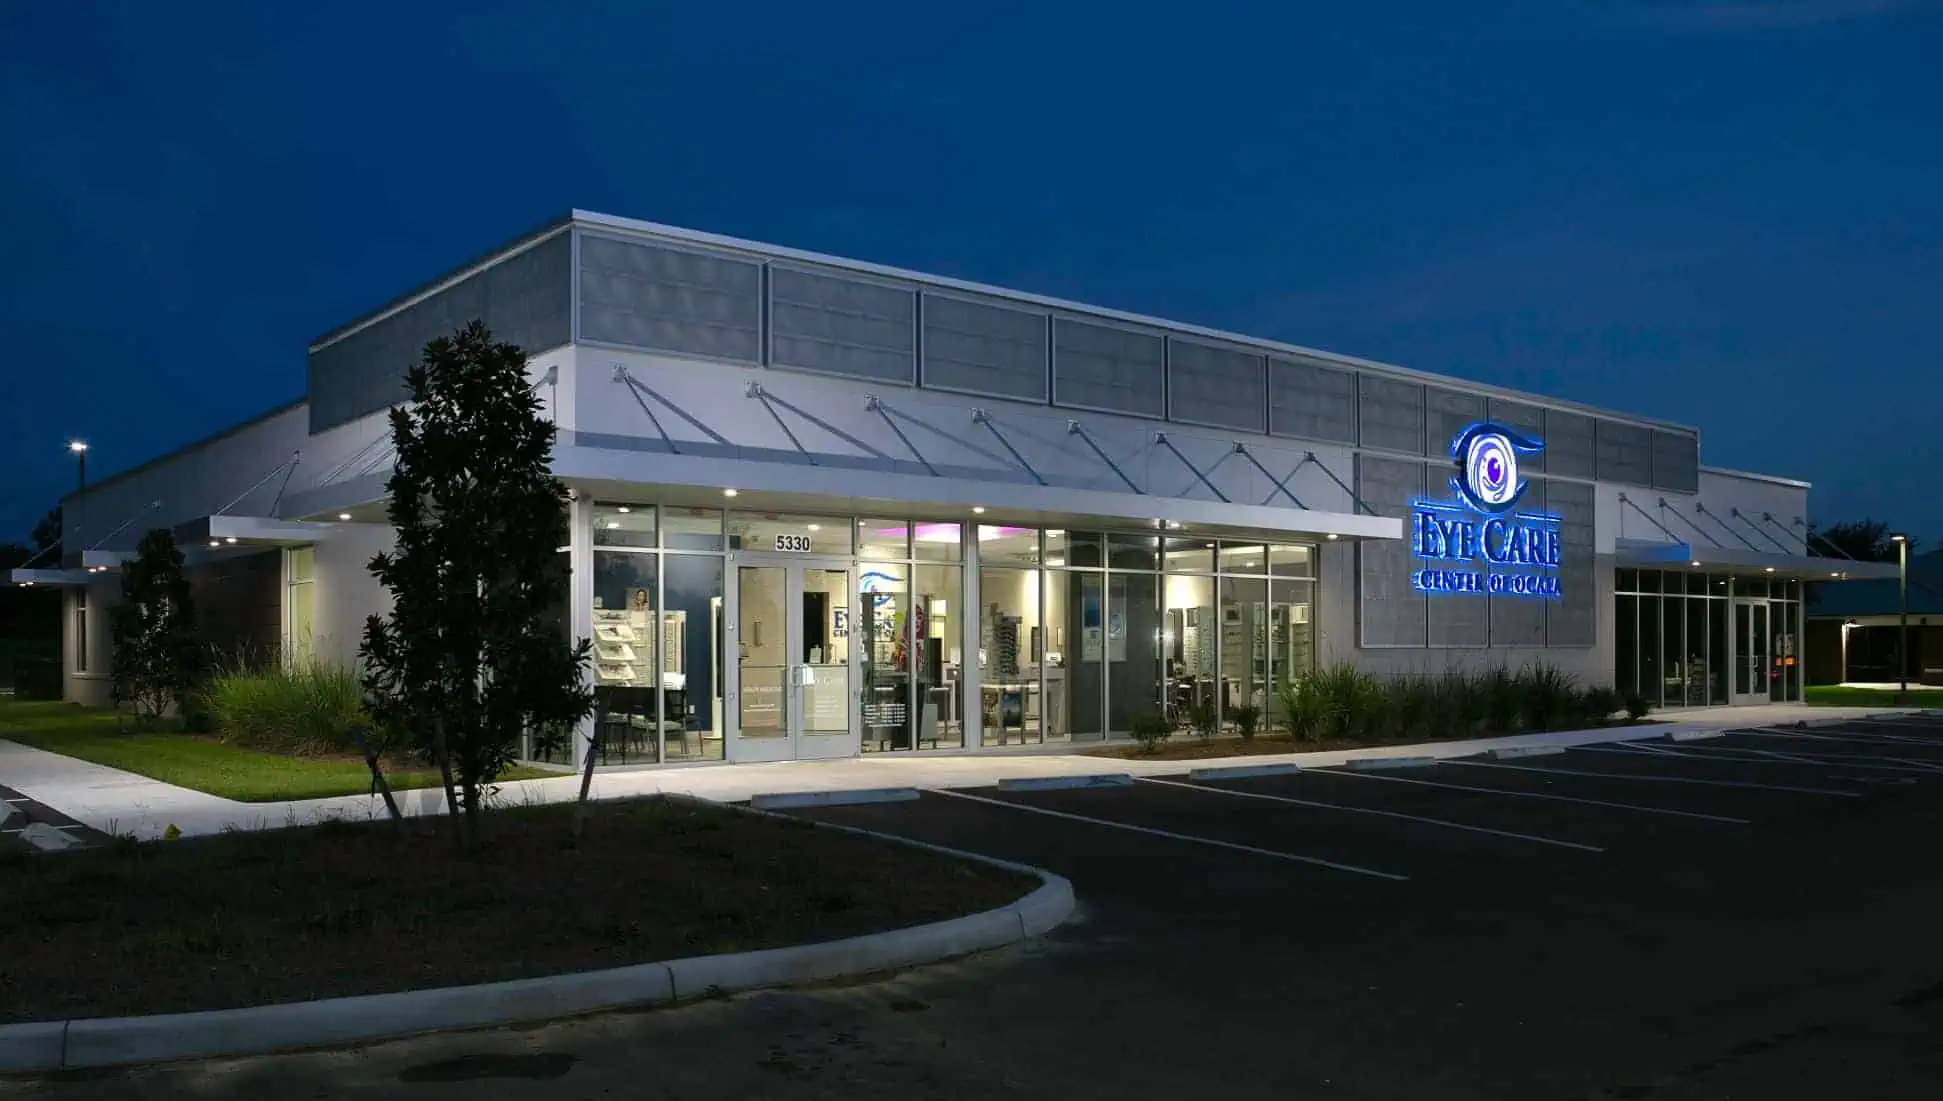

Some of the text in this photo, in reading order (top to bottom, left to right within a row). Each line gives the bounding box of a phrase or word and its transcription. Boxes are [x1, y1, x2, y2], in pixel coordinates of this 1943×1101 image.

[777, 535, 810, 551] 5330
[1416, 512, 1561, 567] EYE CARE
[1415, 569, 1483, 593] CENTER
